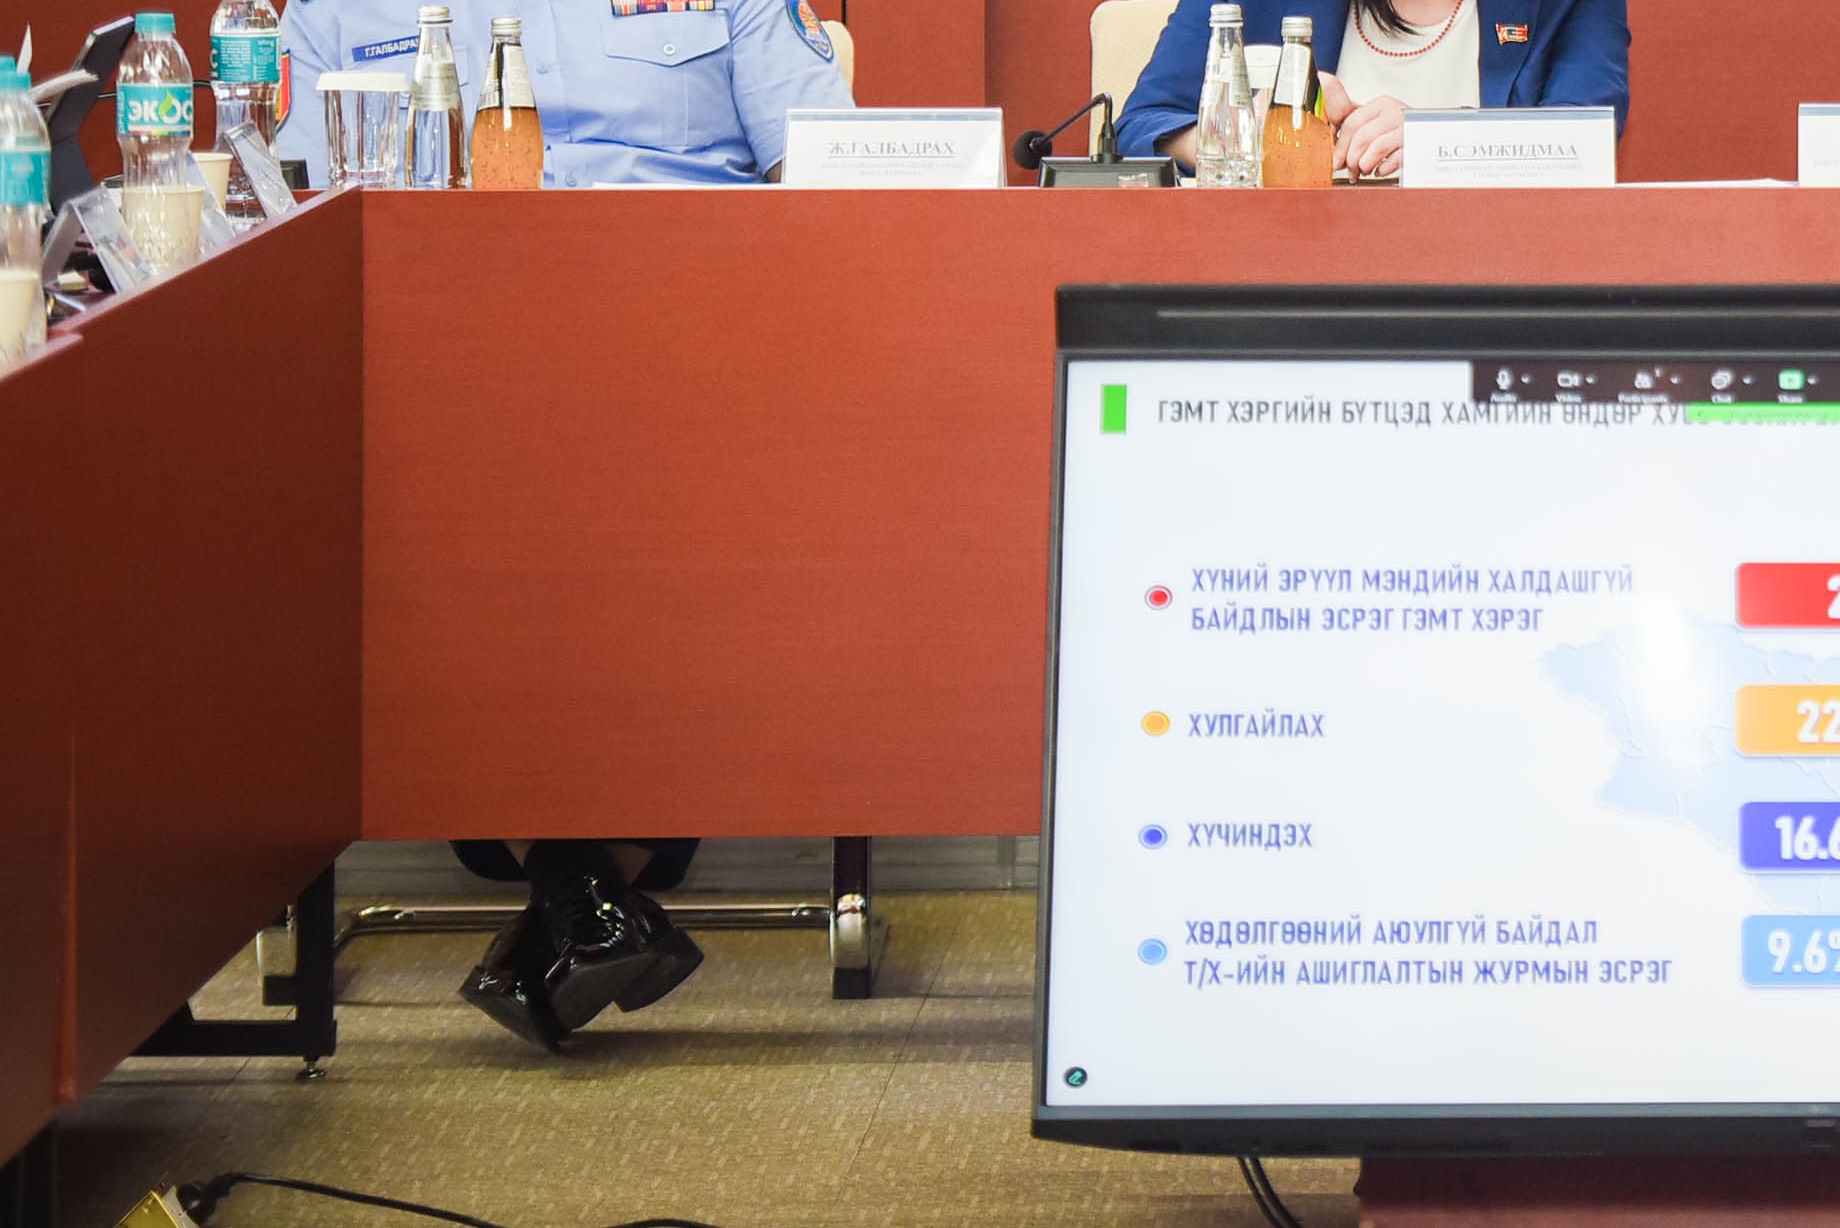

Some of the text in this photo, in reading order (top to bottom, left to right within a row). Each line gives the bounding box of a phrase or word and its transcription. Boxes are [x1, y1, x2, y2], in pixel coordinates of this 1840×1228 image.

[1157, 400, 1220, 423] ГЭМТ
[1227, 395, 1332, 424] ХЭРГИЙН
[1341, 400, 1432, 429] БҮТЦЭД
[1191, 563, 1634, 596] ХҮНИЙ ЭРҮҮЛ МЭНДИЙН ХАЛДАШГҮЙ
[1191, 602, 1544, 635] БАЙДЛЫН ЭСРЭГ ГЭМТ ХЭРЭГ
[1187, 708, 1326, 739] ХУЛГАЙЛАХ
[1186, 822, 1313, 852] ХҮЧИНДЭХ
[1185, 915, 1599, 949] ХӨДӨЛГӨӨНИЙ АЮУЛГҮЙ БАЙДАЛ
[1184, 954, 1674, 990] Т/Х-ИЙН АШИГЛАЛТЫН ЖУРМЫН ЭСРЭГ
